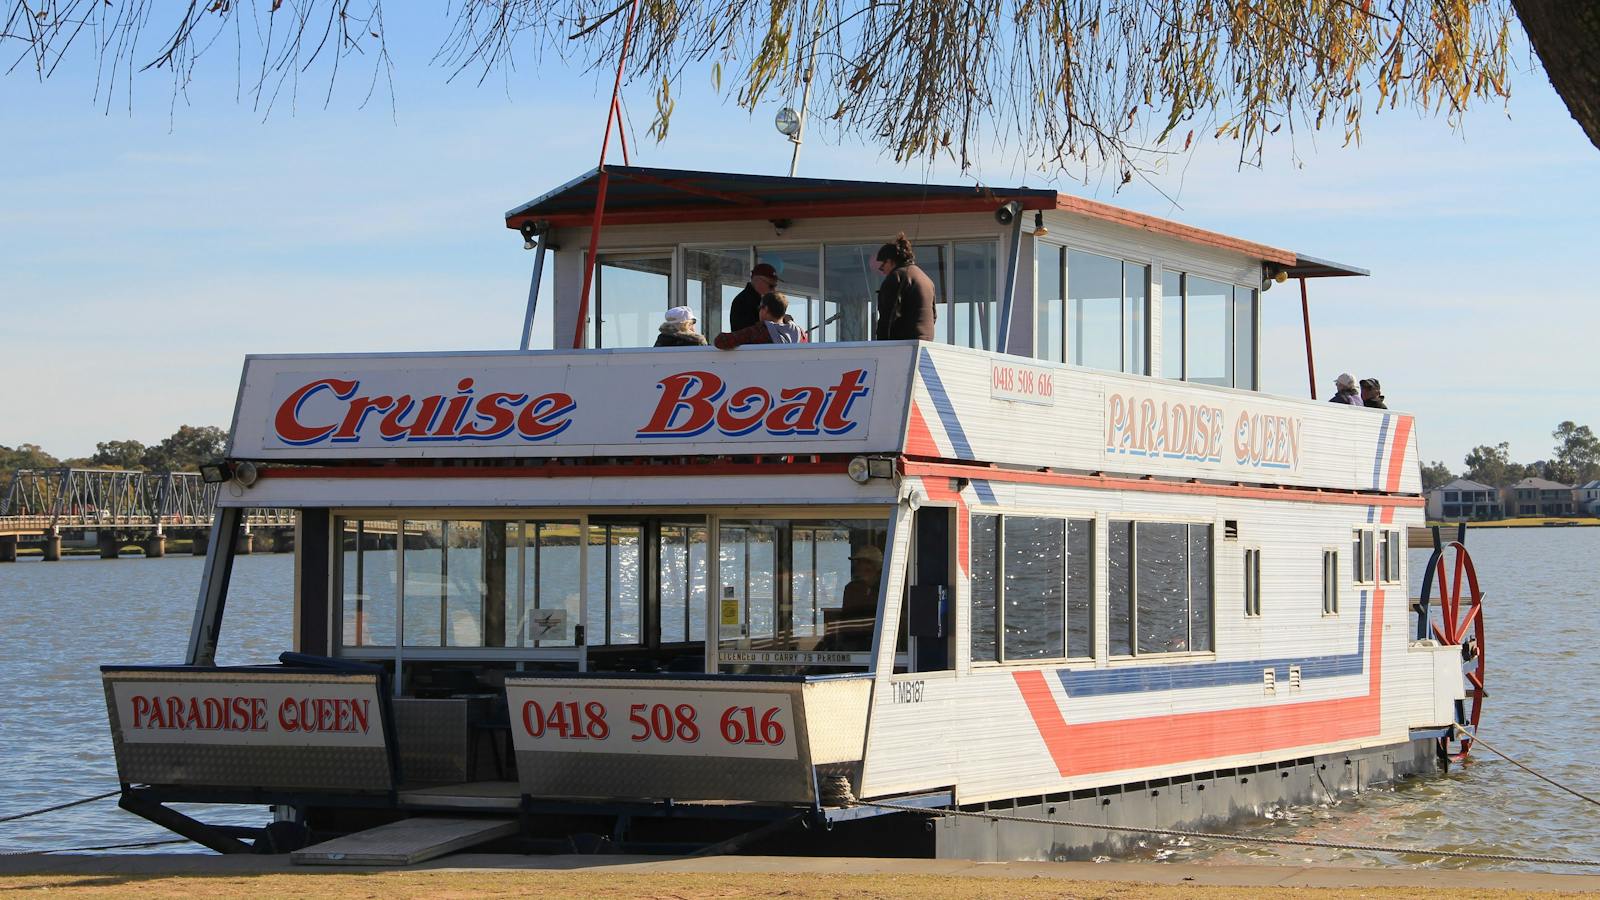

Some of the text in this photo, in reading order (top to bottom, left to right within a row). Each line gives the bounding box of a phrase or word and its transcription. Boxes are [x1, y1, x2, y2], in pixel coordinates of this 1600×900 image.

[993, 366, 1053, 397] 0418 508 616
[273, 368, 869, 446] Cruise Boat
[1106, 392, 1303, 473] PARADISE QUEEN
[761, 652, 770, 661] TO
[774, 653, 797, 662] CARRY
[891, 680, 925, 704] TMB187
[130, 695, 371, 735] PARADISE QUEEN
[522, 699, 786, 746] 0418 508 616
